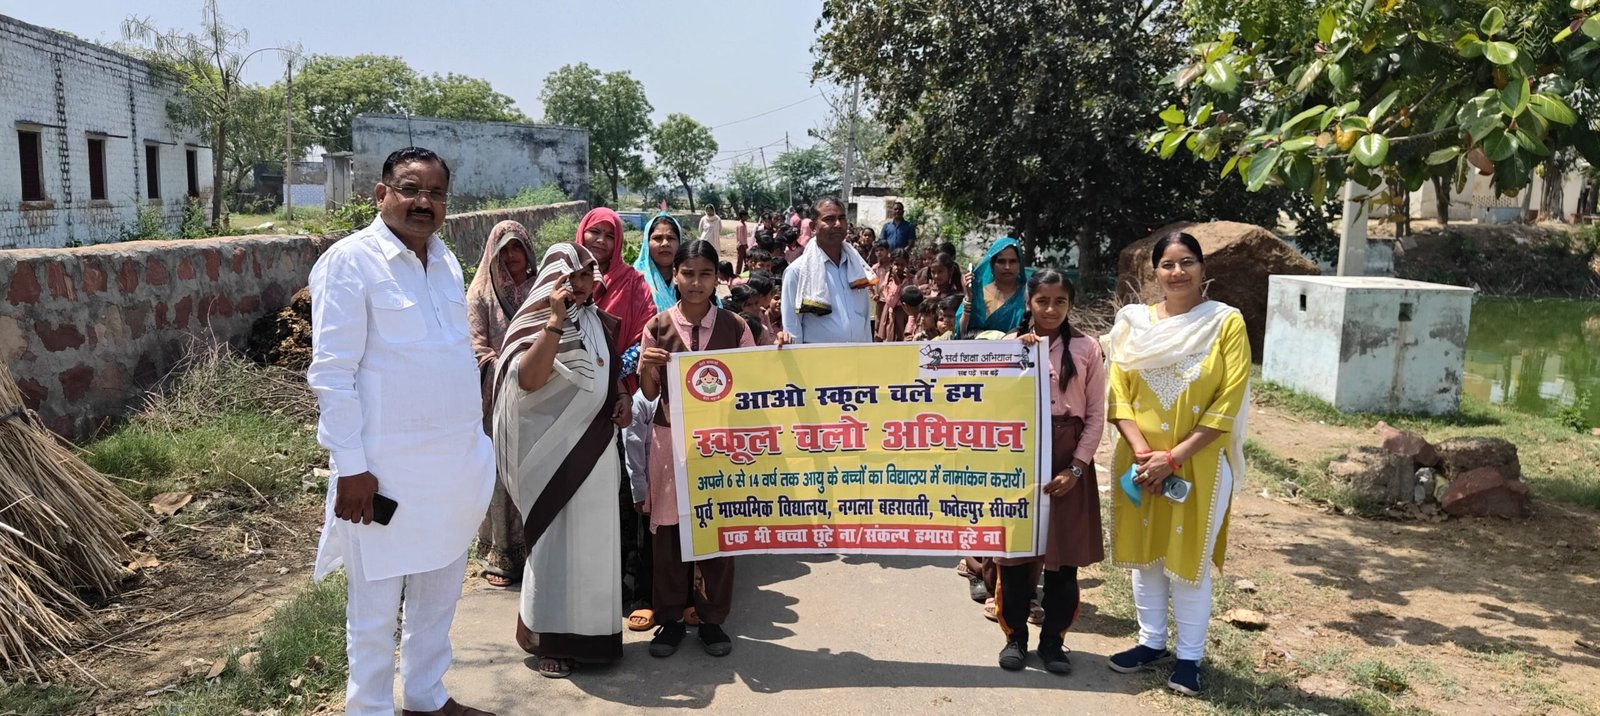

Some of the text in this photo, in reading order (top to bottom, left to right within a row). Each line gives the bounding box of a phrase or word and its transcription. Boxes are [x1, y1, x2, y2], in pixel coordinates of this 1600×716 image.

[945, 351, 1013, 363] सर्व शिक्षा अभियान
[735, 379, 984, 412] आओ स्कूल चलें हम
[693, 411, 1027, 464] स्कूल चलो अभियान
[697, 469, 724, 490] अपने
[726, 473, 733, 488] 6
[735, 468, 745, 488] से
[749, 474, 759, 488] 14
[762, 467, 778, 488] वर्ष
[780, 472, 800, 487] तक
[803, 471, 825, 493] आयु
[827, 465, 838, 486] के
[841, 464, 867, 485] बच्चों
[868, 469, 883, 485] का
[886, 463, 927, 485] विद्यालय
[930, 464, 942, 485] में
[943, 465, 988, 487] नामांकन
[694, 494, 1029, 528] पूर्व माध्यमिक विद्यालय, नगला बहरावती, फतेहपुर सीकरी
[722, 529, 749, 546] एक
[754, 526, 771, 544] भी
[775, 527, 809, 543] बच्चा
[811, 525, 834, 547] छूटे
[914, 529, 954, 545] हमारा
[958, 527, 979, 549] टूटे
[982, 530, 1002, 546] ना
